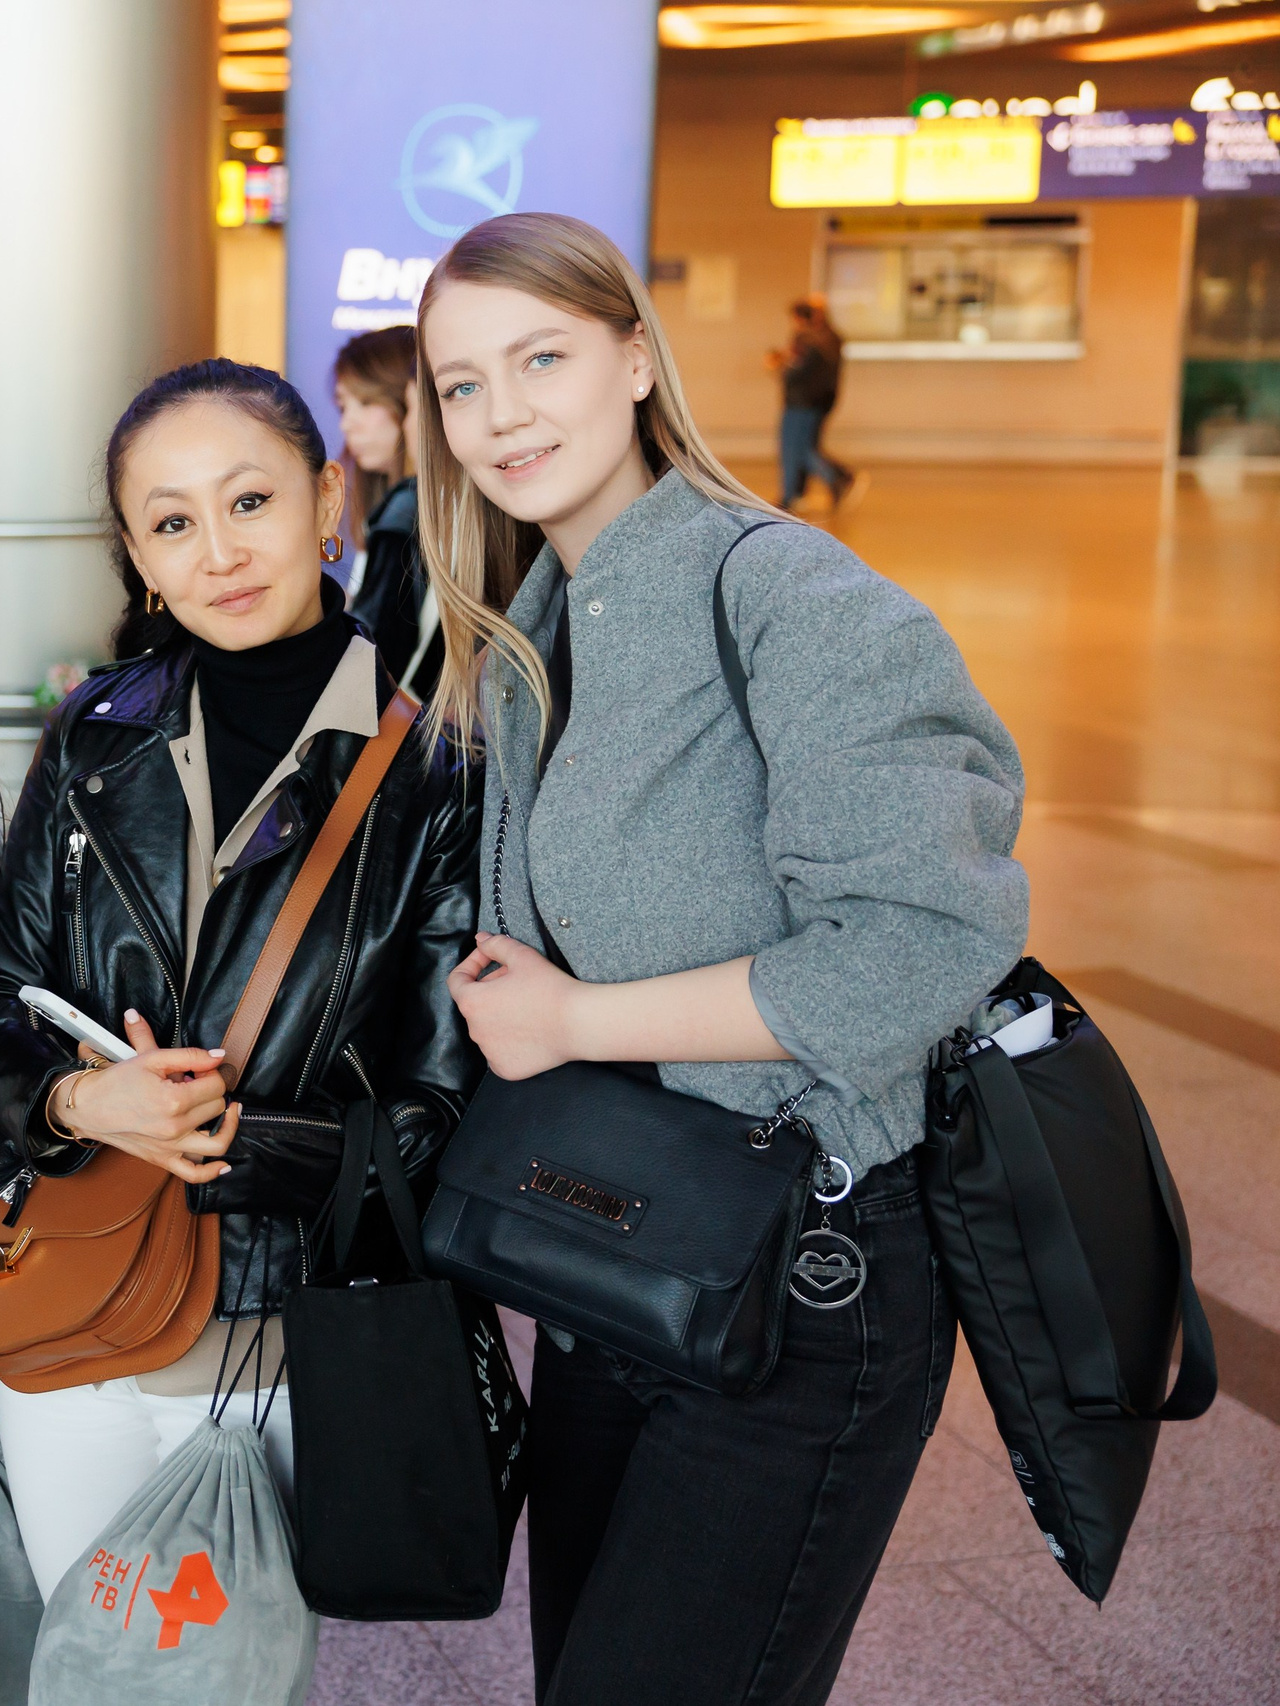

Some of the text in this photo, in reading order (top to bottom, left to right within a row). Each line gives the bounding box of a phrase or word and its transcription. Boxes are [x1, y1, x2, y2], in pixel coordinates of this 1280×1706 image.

[473, 1350, 500, 1433] KARL
[87, 1547, 132, 1585] РЕН
[90, 1580, 119, 1612] ТВ
